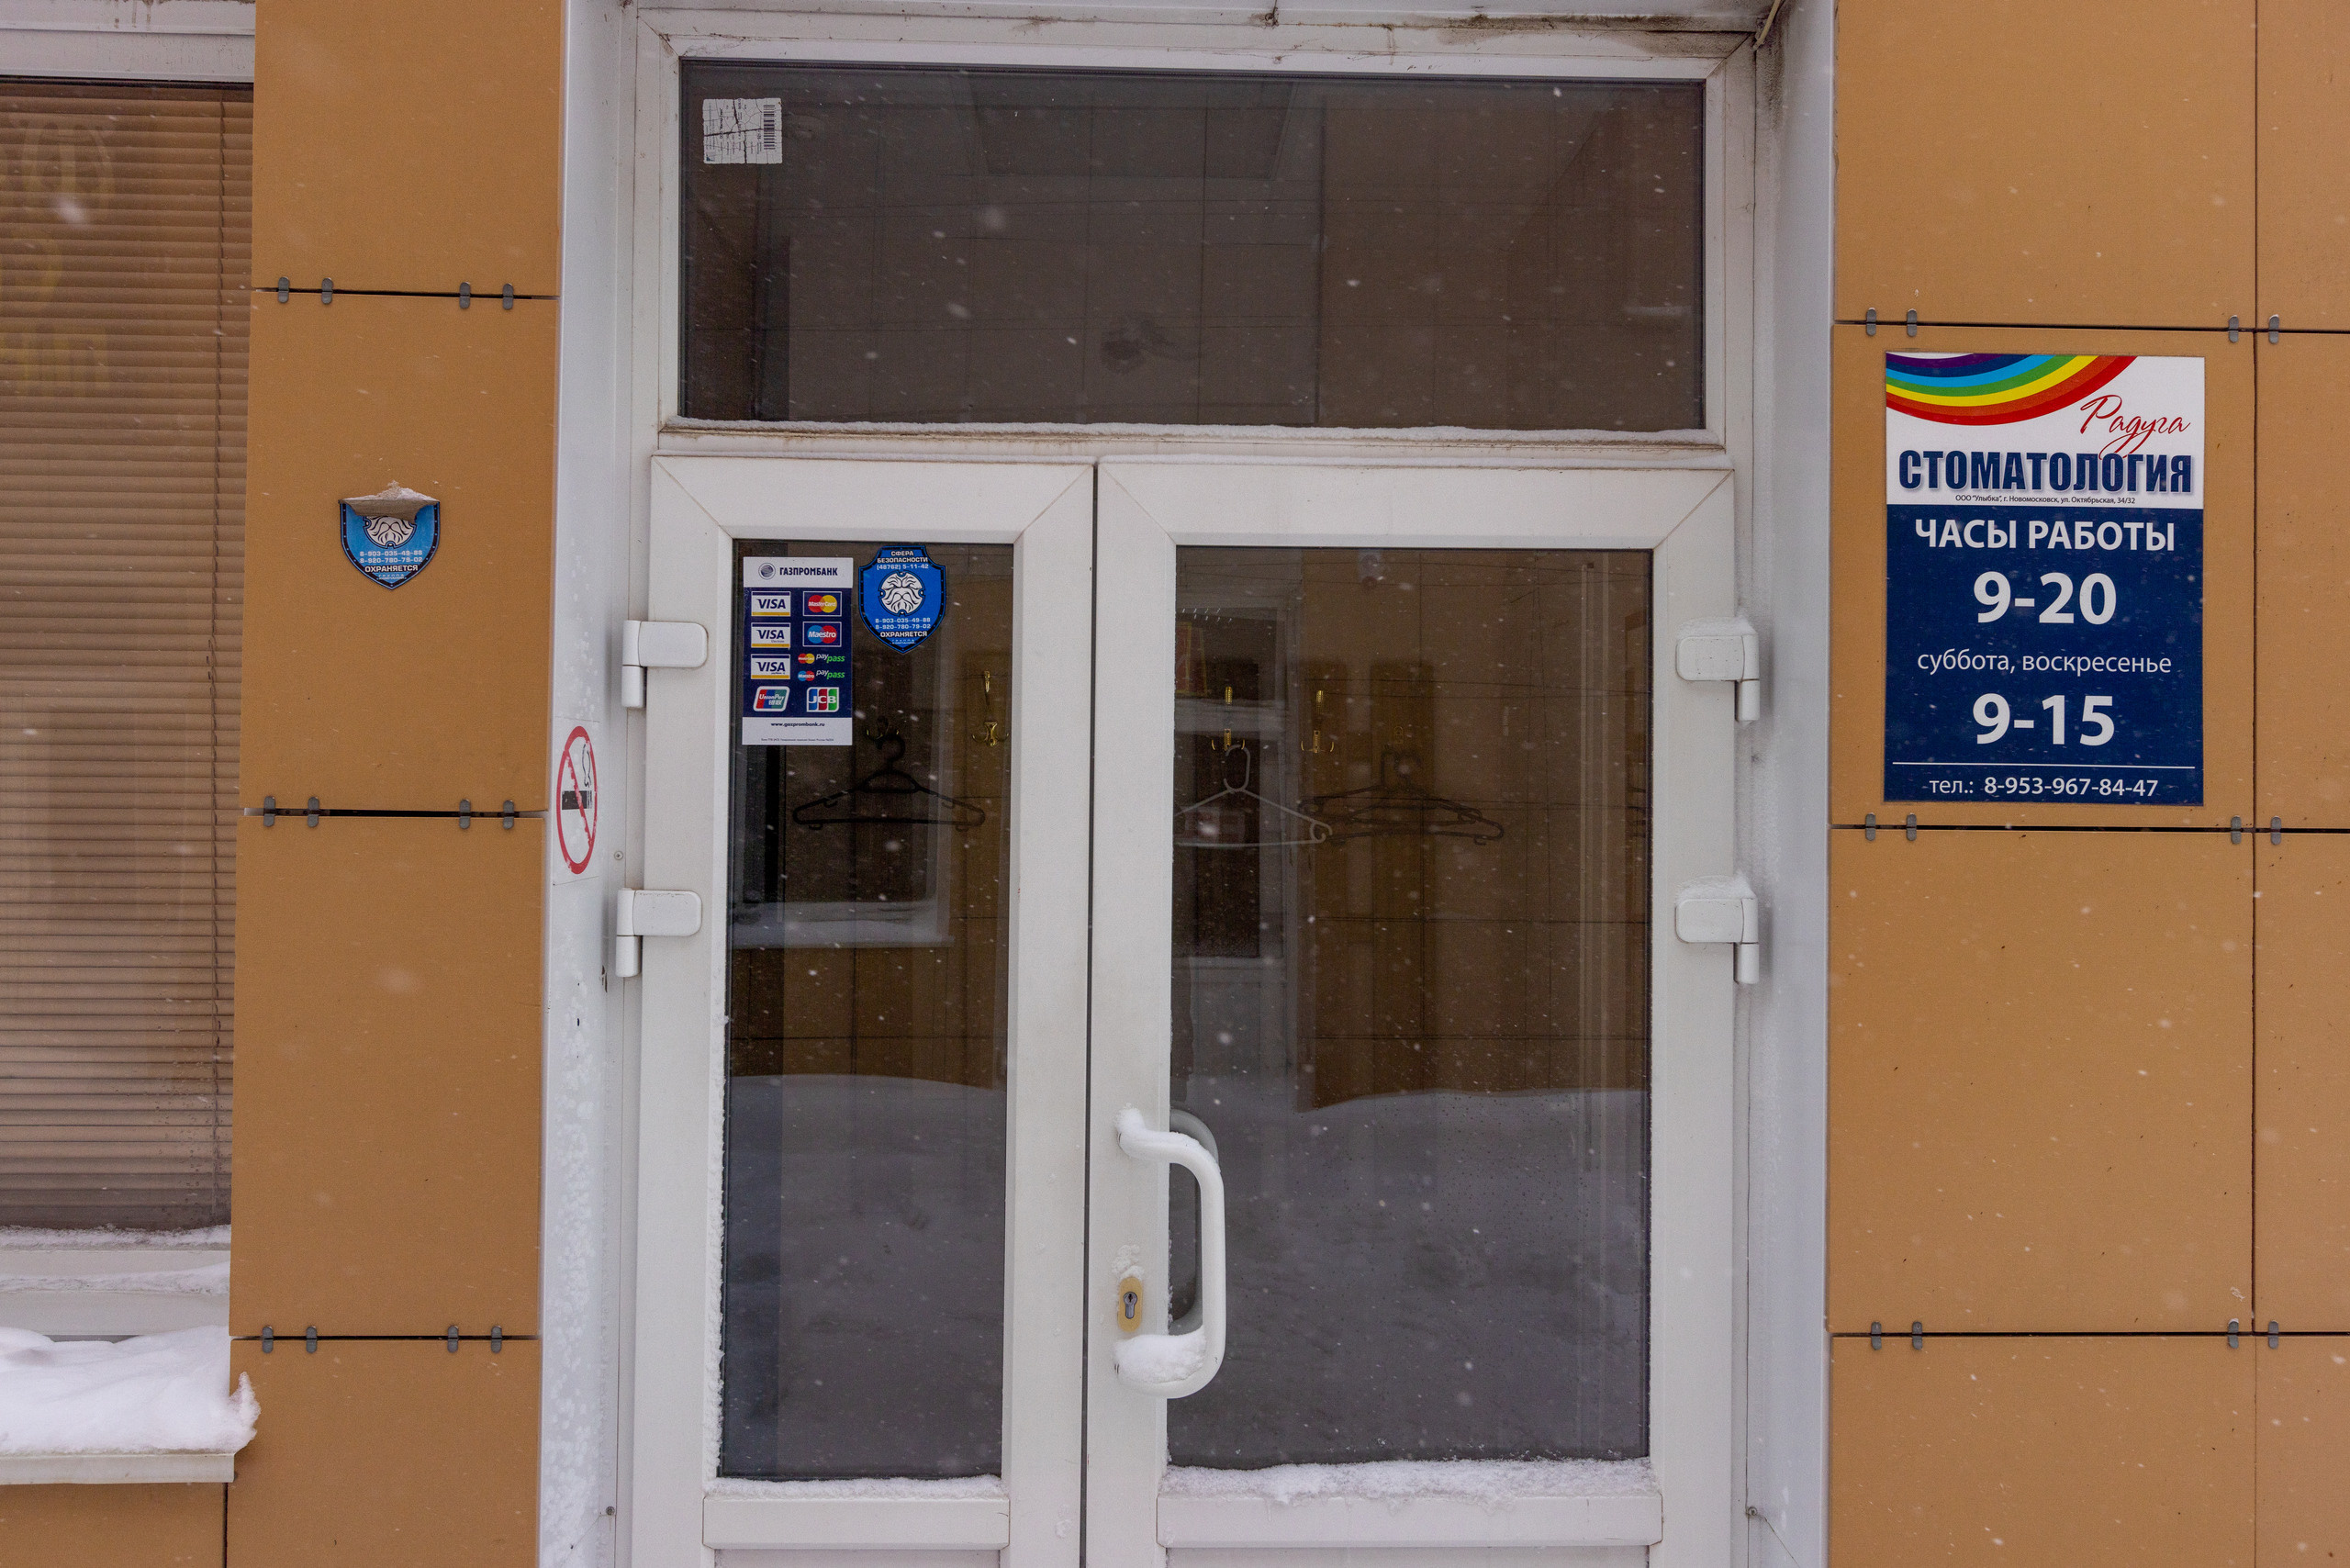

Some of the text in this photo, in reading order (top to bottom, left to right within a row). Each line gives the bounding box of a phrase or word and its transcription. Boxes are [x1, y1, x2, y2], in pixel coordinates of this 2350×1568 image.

[2080, 394, 2191, 460] Радуга
[1898, 450, 2192, 493] СТОМАТОЛОГИЯ
[2009, 496, 2059, 504] Новомосковск,
[1915, 519, 2175, 551] ЧАСЫ РАБОТЫ
[364, 565, 419, 573] ОХРАНЯЕТСЯ
[779, 567, 838, 576] ГАЗПРОМБАНК
[756, 599, 787, 610] VISA
[1974, 571, 2117, 625] 9-20
[756, 630, 785, 640] VISA
[755, 661, 786, 672] VISA
[1918, 649, 2172, 677] суббота, воскресенье
[808, 695, 836, 704] JCB
[1973, 693, 2115, 746] 9-15
[1929, 777, 2159, 797] тел.: 8-953-967-84-47
